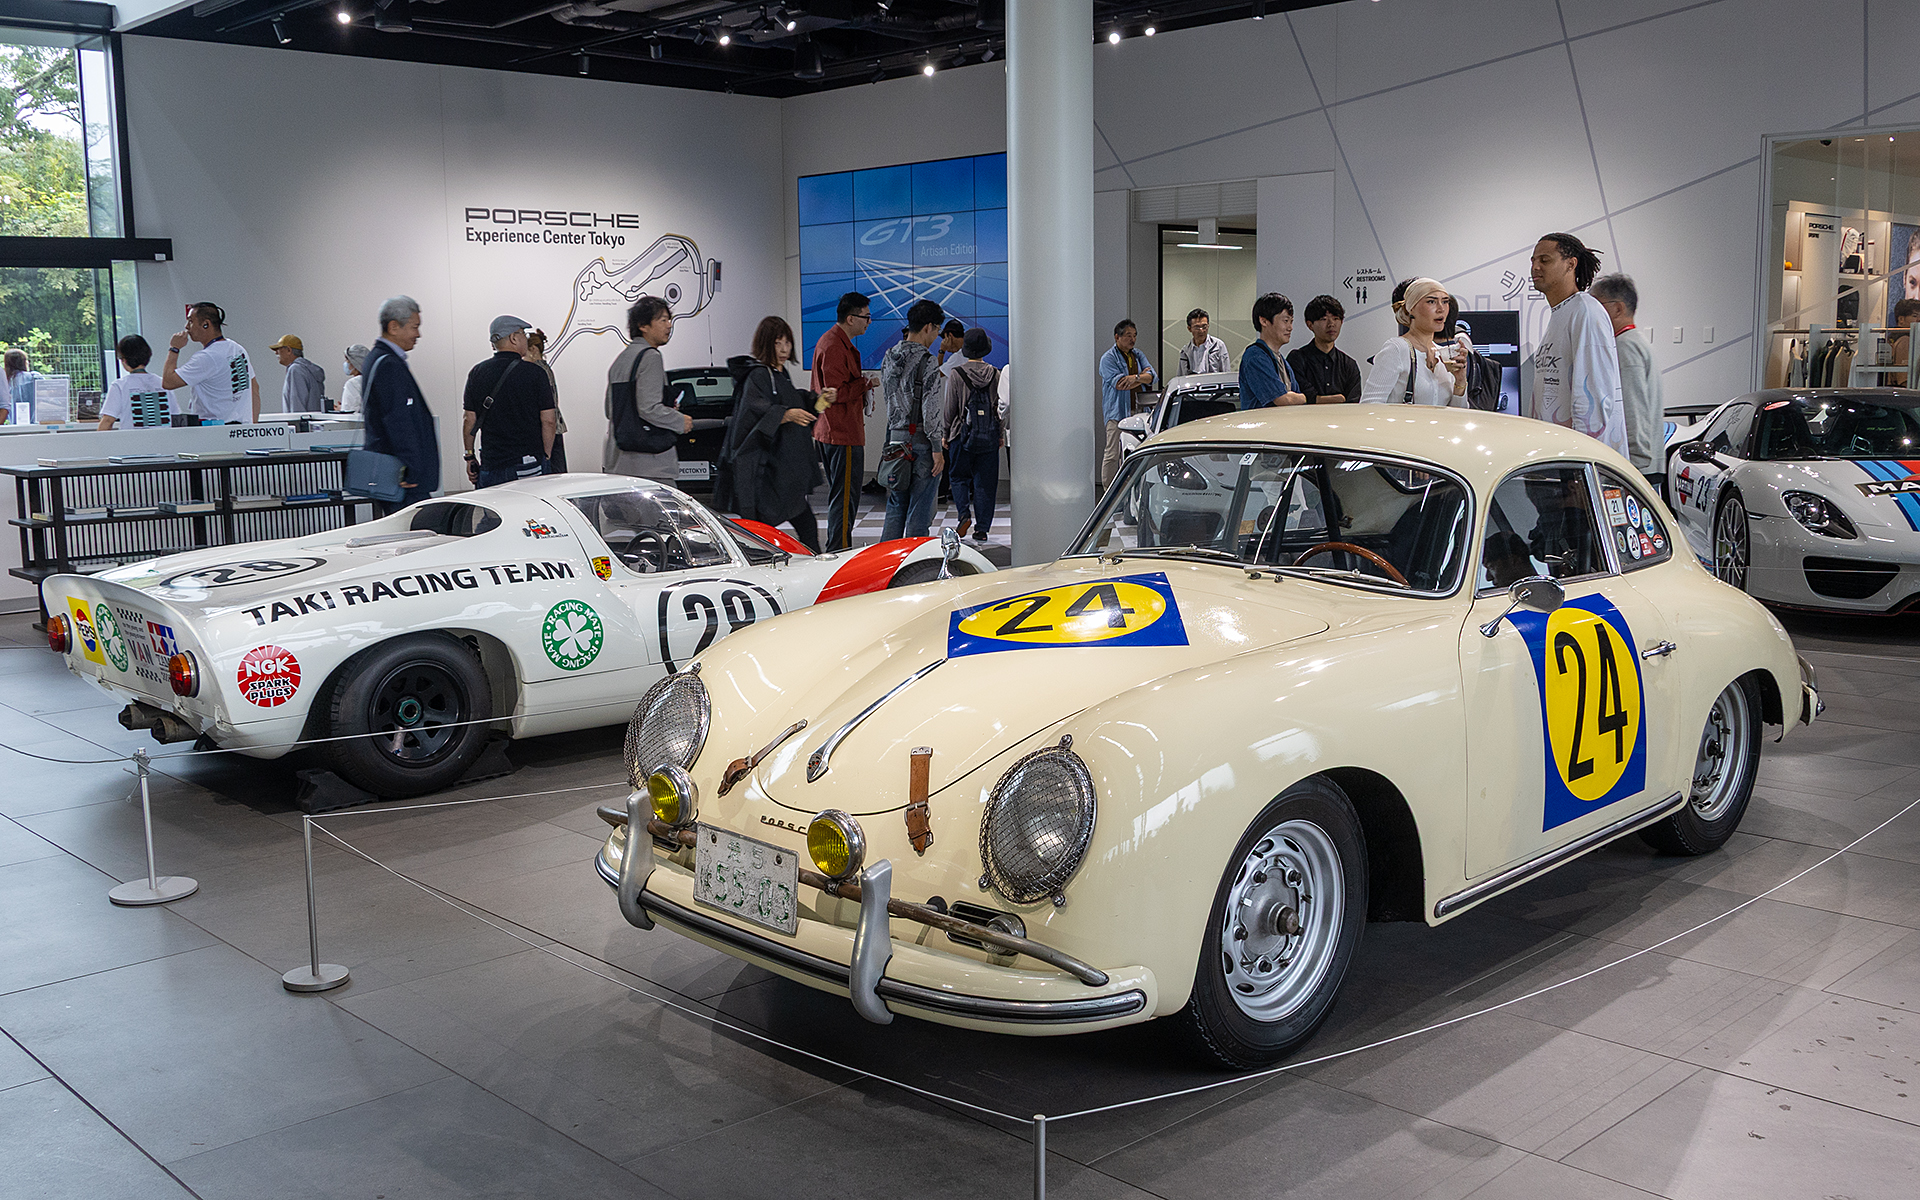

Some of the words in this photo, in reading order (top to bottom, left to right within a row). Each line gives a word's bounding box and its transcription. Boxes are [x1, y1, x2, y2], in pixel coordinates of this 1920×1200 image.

[465, 207, 640, 229] PORSCHE
[466, 227, 540, 246] Experience
[543, 229, 586, 246] Center
[588, 231, 625, 249] Tokyo
[860, 215, 953, 246] GT3
[921, 245, 949, 257] Artisan
[950, 243, 978, 256] Edition
[1356, 275, 1386, 283] RESTROOMS
[229, 427, 285, 438] #PECTOKYO
[191, 561, 300, 583] 28
[241, 590, 336, 627] TAKI
[340, 568, 479, 606] RACING
[480, 561, 575, 586] TEAM
[547, 602, 583, 625] RACING
[584, 608, 601, 638] MATE
[993, 584, 1135, 636] 24
[127, 639, 154, 666] VAN
[544, 632, 561, 663] MATE
[562, 645, 598, 668] RACING
[245, 656, 290, 677] NGK
[250, 677, 290, 691] SPARK
[250, 687, 292, 700] PLUGS
[1554, 623, 1628, 783] 24
[760, 815, 807, 835] PORSC
